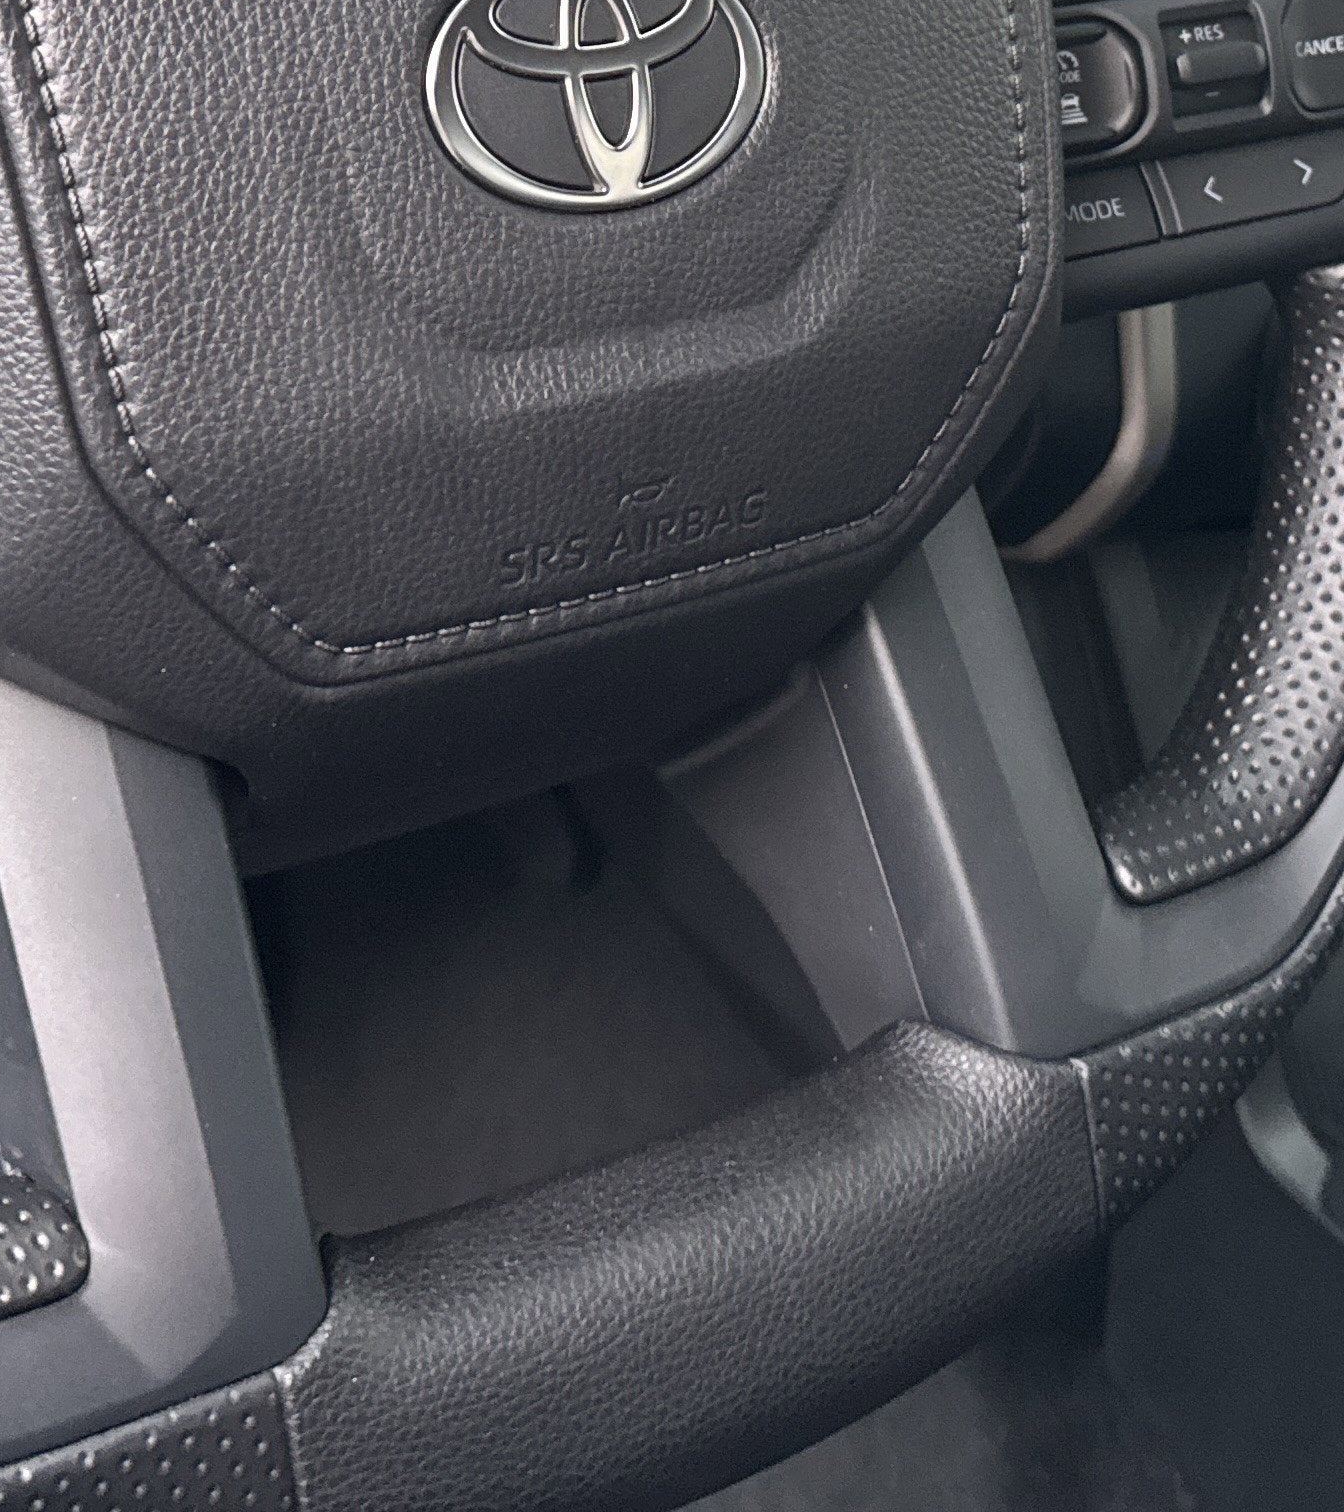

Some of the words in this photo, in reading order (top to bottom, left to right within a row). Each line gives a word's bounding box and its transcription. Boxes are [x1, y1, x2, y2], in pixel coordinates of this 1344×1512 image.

[1059, 70, 1082, 84] ODE
[505, 541, 589, 589] SRS
[607, 491, 769, 565] AIRBAG
